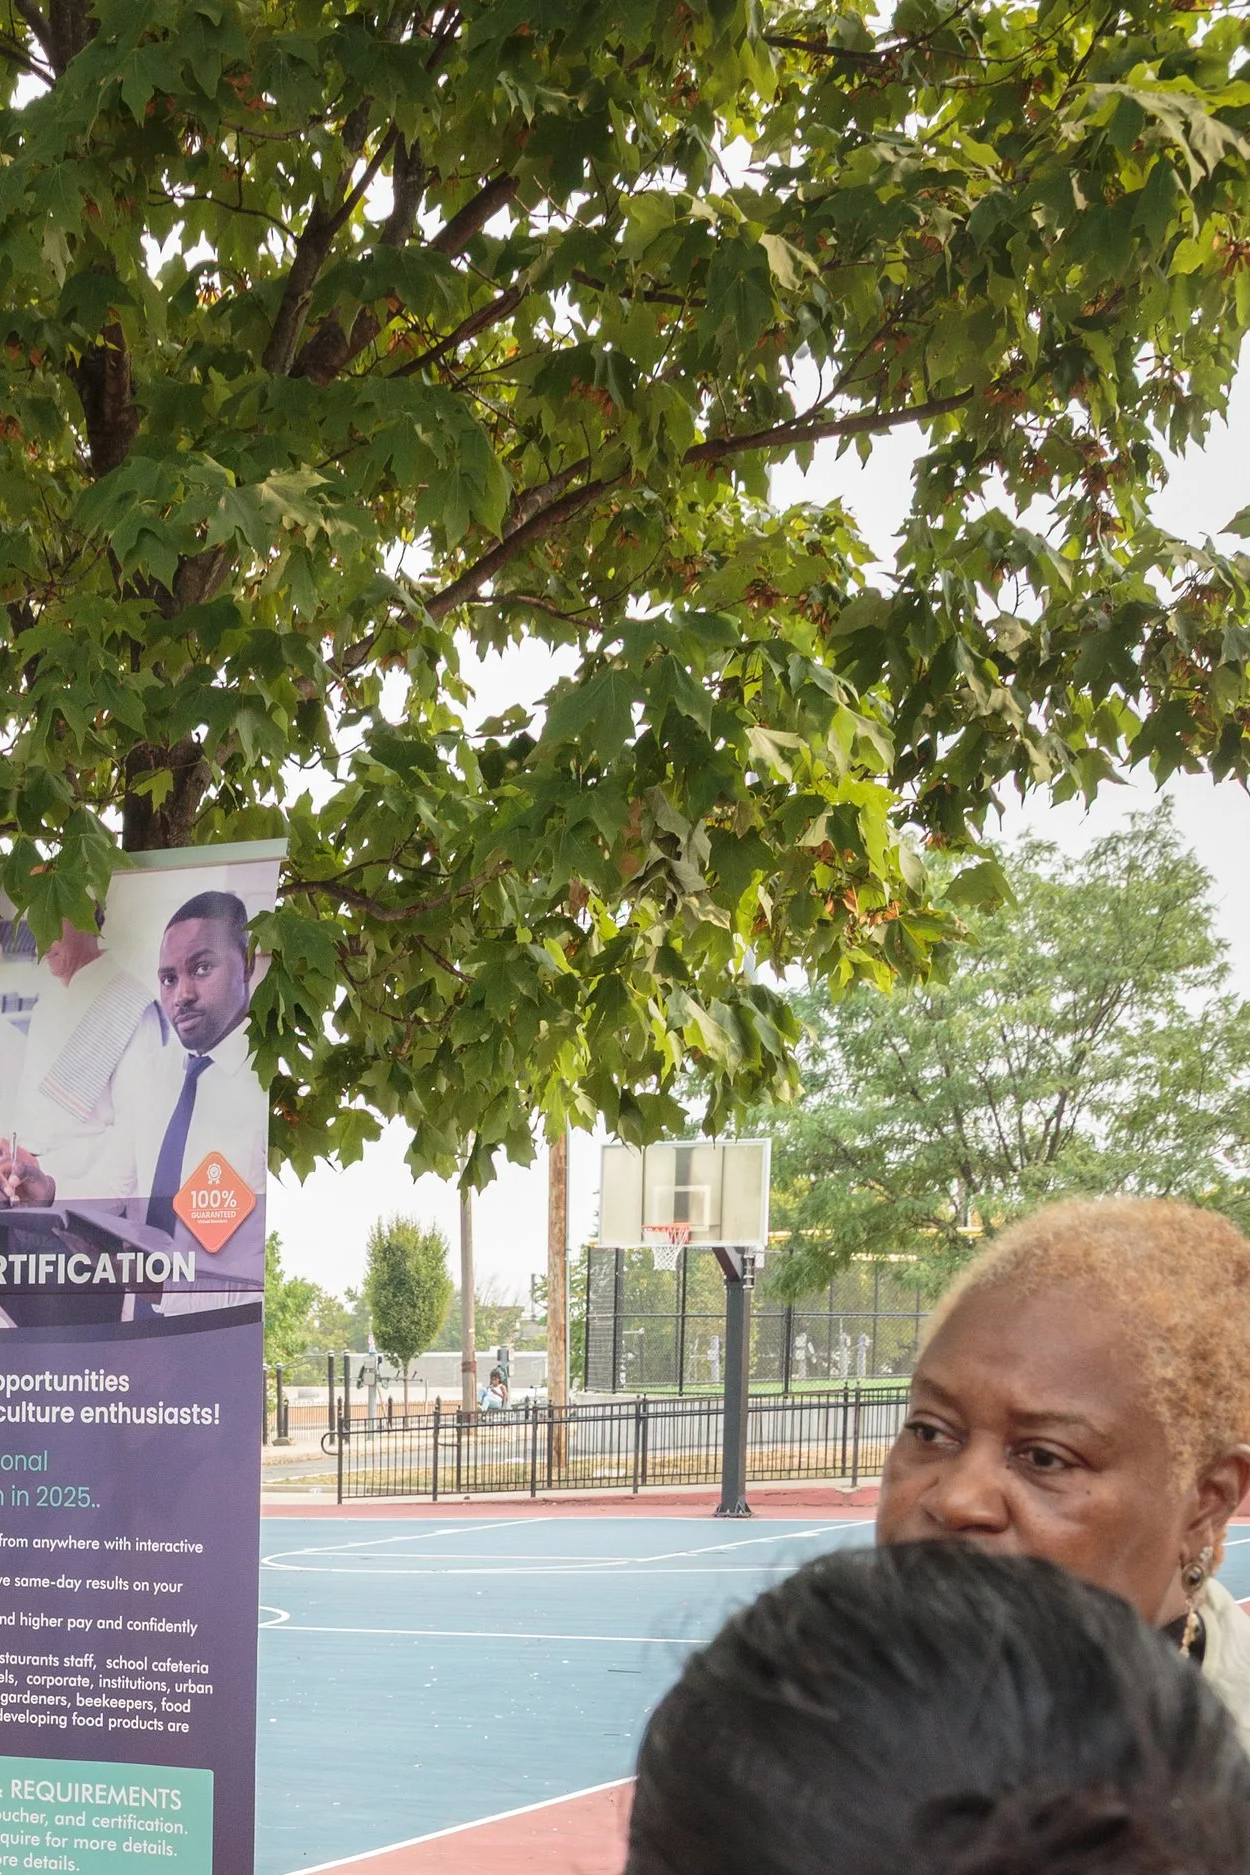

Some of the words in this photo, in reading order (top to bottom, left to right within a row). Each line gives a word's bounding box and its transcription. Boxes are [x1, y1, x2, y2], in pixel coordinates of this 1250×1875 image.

[191, 1190, 237, 1209] 100%
[191, 1211, 236, 1219] GUARANTEED
[80, 1401, 219, 1424] enthusiasts!
[12, 1485, 28, 1506] in
[37, 1486, 100, 1508] 2025..
[33, 1535, 100, 1552] anywhere
[104, 1536, 131, 1550] with
[136, 1538, 203, 1553] interactive
[15, 1574, 82, 1592] same-day
[86, 1576, 129, 1590] results
[133, 1582, 149, 1591] on
[153, 1582, 183, 1595] your
[20, 1612, 63, 1630] higher
[68, 1618, 92, 1632] pay
[97, 1616, 122, 1630] and
[127, 1617, 198, 1636] confidently
[64, 1654, 96, 1670] staff,
[106, 1655, 147, 1670] school
[152, 1658, 208, 1674] cafeteria
[27, 1675, 93, 1689] corporate,
[100, 1674, 170, 1694] institutions,
[175, 1679, 212, 1694] urban
[1, 1690, 70, 1708] gardeners,
[77, 1692, 156, 1713] beekeepers,
[161, 1697, 190, 1712] food
[11, 1780, 182, 1810] REQUIREMENTS
[55, 1812, 85, 1826] and
[92, 1814, 188, 1834] certification.
[23, 1853, 80, 1871] details.
